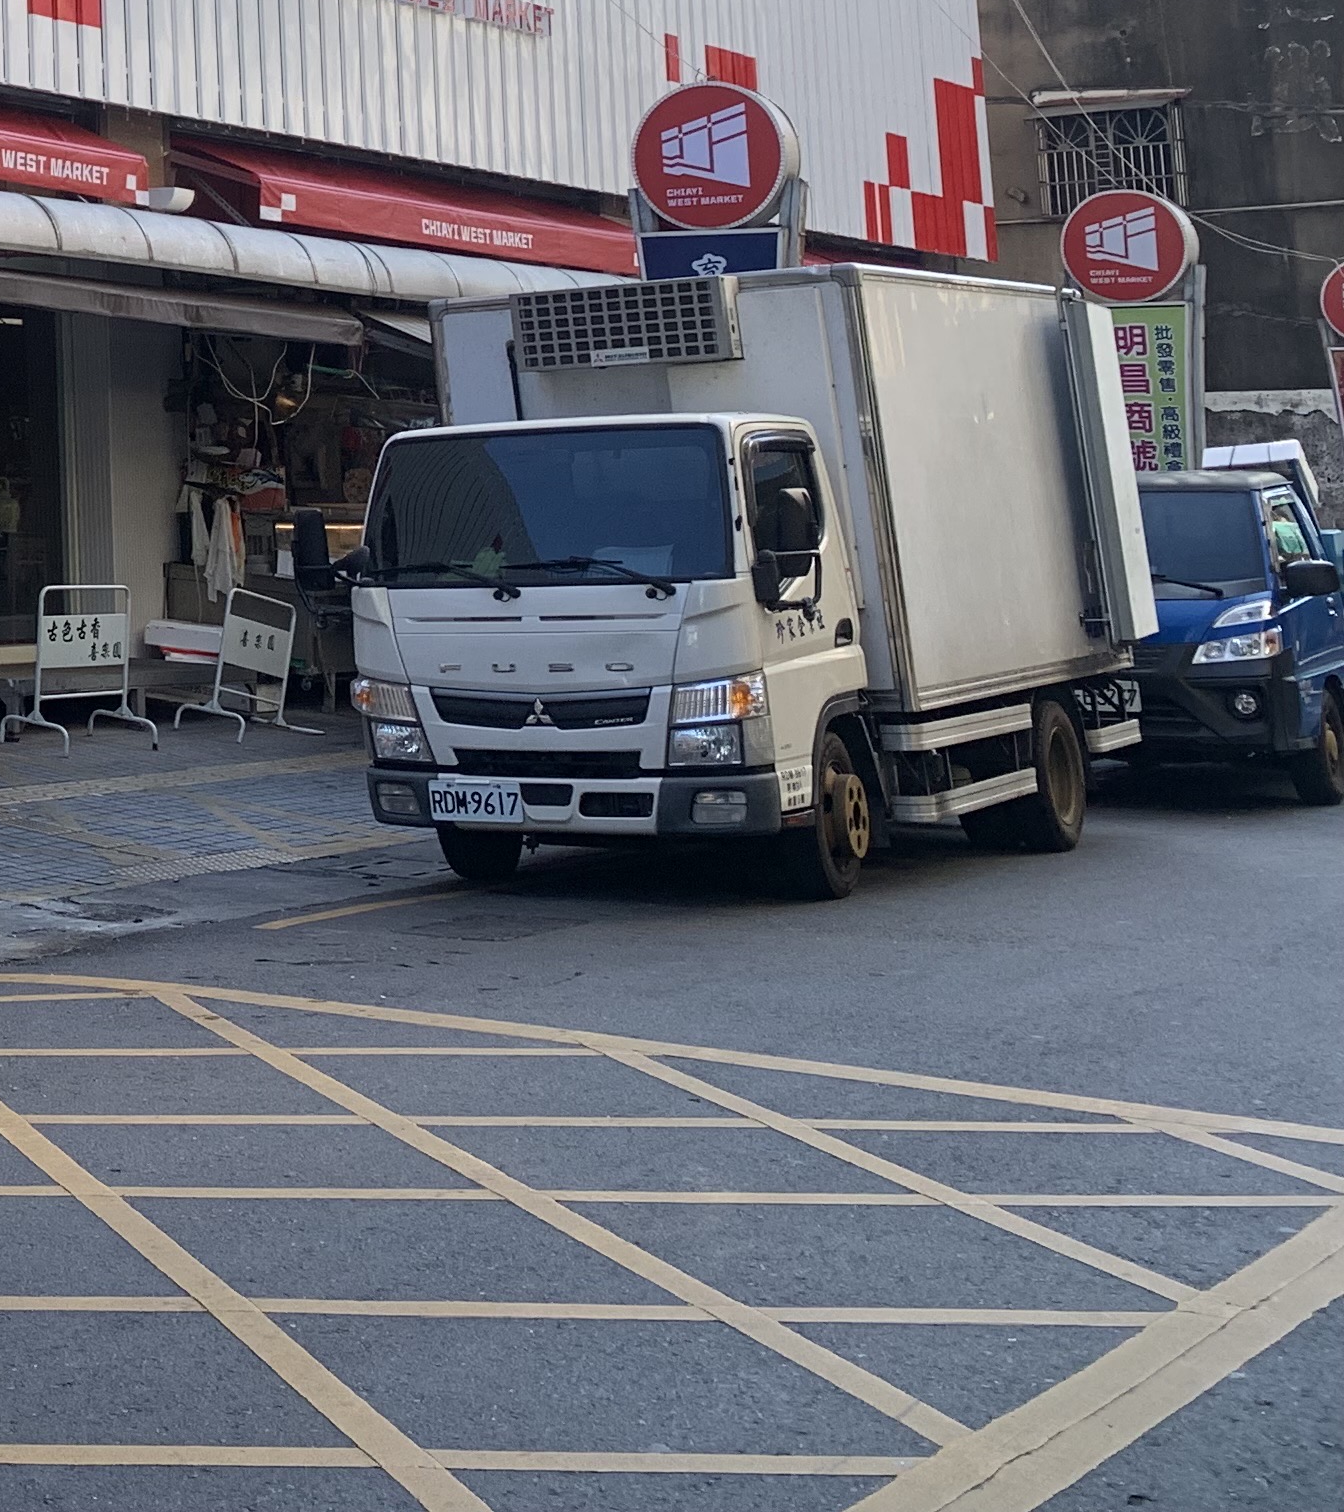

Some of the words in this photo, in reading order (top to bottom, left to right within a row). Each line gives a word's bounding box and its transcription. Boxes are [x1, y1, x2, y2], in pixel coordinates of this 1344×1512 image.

[1, 148, 47, 175] WEST
[50, 157, 109, 186] MARKET
[666, 187, 703, 197] CHIAYI
[667, 199, 698, 207] WEST
[700, 194, 744, 206] MARKET
[421, 218, 459, 240] CHIAYI
[460, 225, 491, 245] WEST
[492, 229, 534, 249] MARKET
[1117, 275, 1153, 283] MARKET
[1113, 324, 1159, 472] 明昌商號
[47, 617, 100, 642] 古色古香
[439, 662, 634, 673] FUSO
[594, 716, 634, 725] CANTER
[431, 790, 519, 816] RDM-9617
